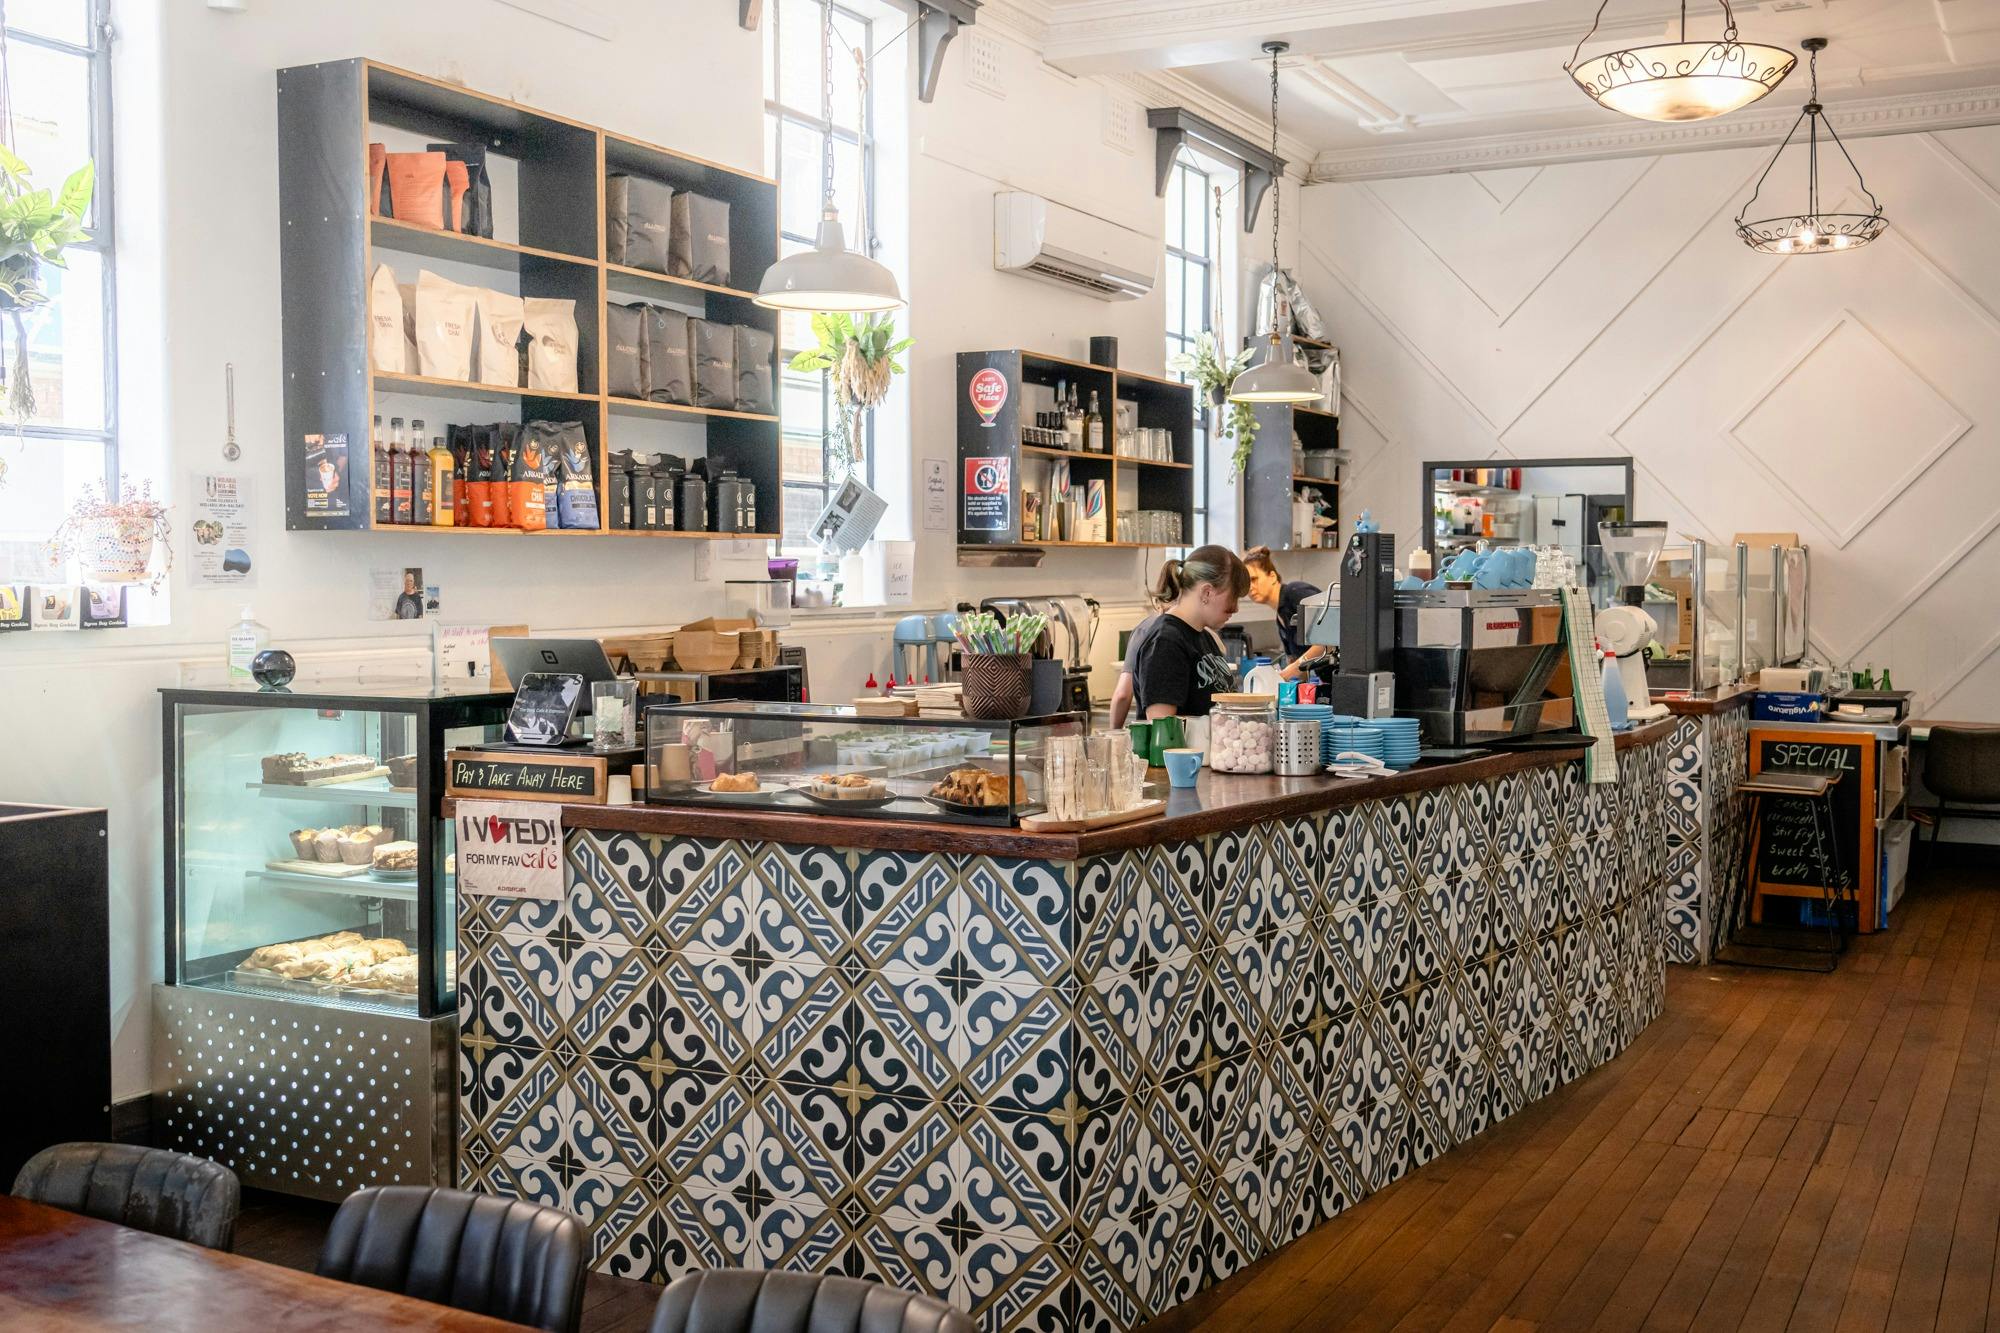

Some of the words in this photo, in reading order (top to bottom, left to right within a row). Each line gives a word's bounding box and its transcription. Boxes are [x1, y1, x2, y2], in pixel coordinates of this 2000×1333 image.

[975, 382, 1002, 395] Safe
[977, 394, 1000, 402] Place
[1771, 743, 1855, 770] SPECIAL
[456, 763, 475, 784] PAY
[487, 764, 513, 786] TAKE
[516, 766, 546, 788] AWAY
[550, 767, 585, 790] HERE
[466, 853, 485, 865] FOR
[486, 854, 501, 865] MY
[502, 855, 520, 866] FAV
